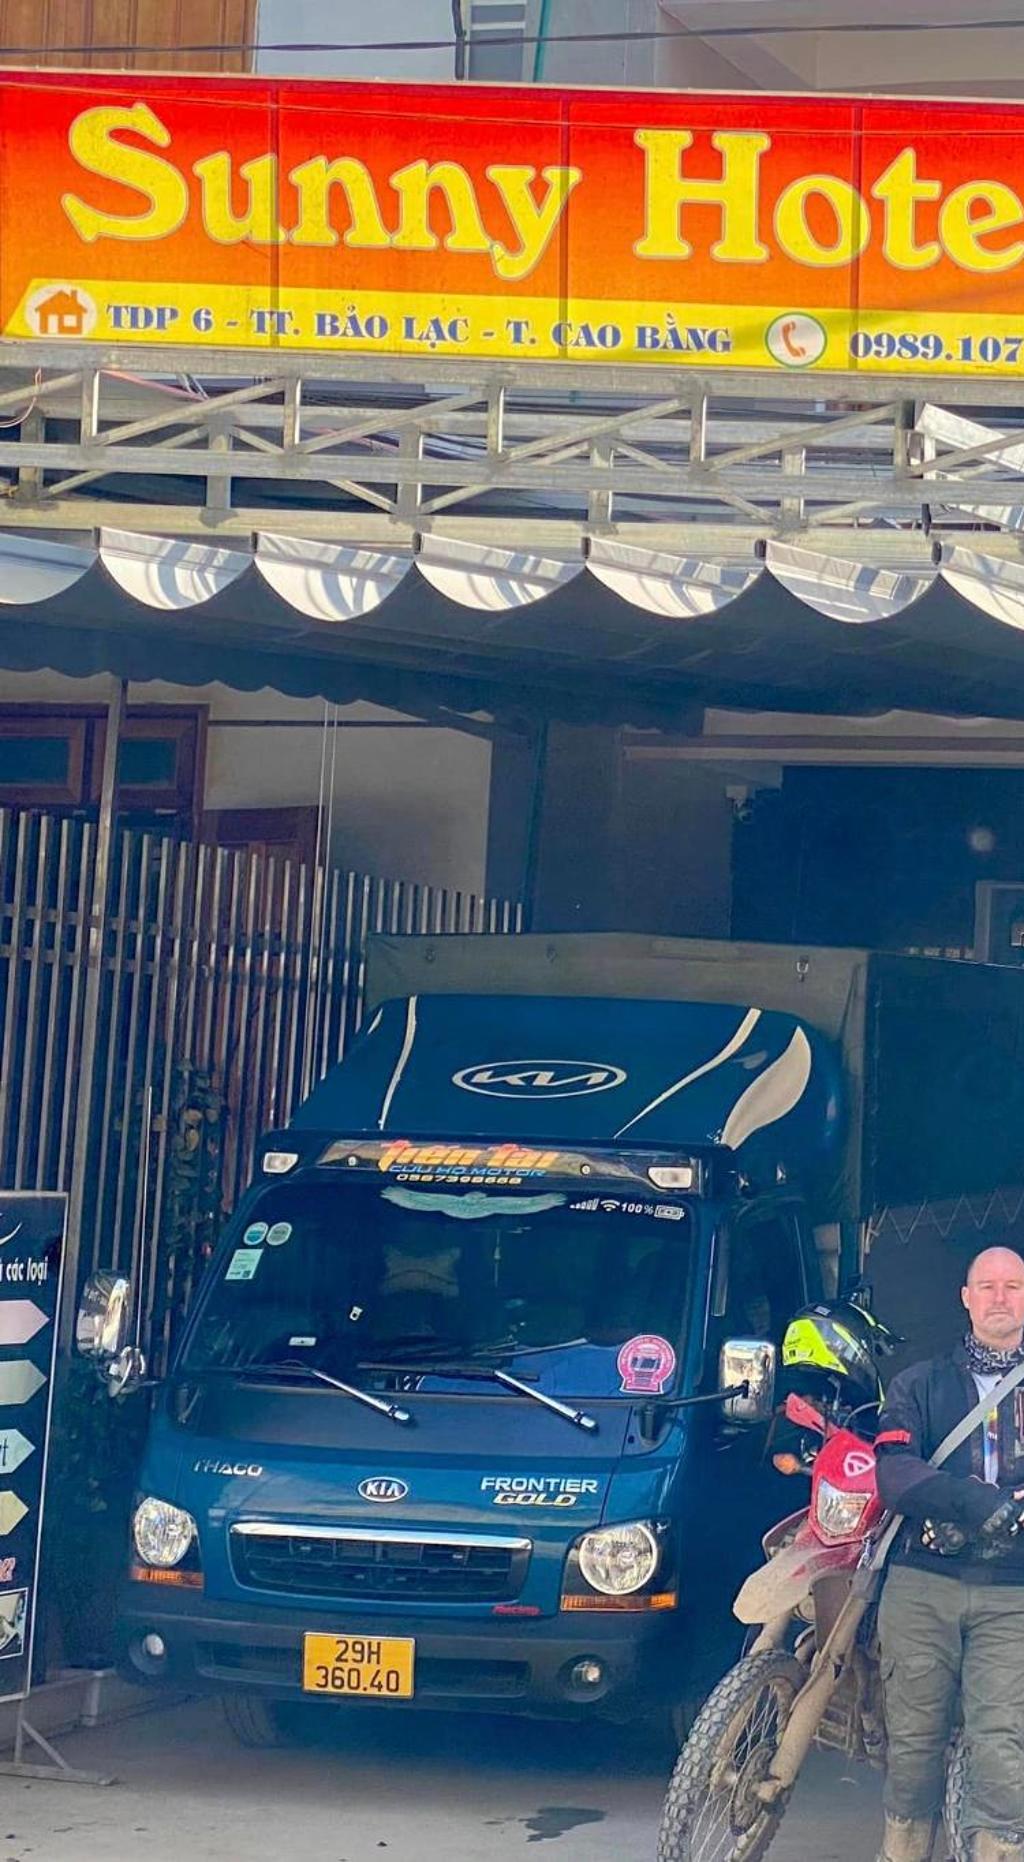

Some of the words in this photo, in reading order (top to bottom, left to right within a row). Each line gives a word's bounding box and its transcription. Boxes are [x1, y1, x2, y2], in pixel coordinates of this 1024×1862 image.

[62, 102, 582, 281] Sunny
[106, 304, 179, 330] TDP
[193, 309, 213, 332] 6
[250, 310, 300, 335] TT.
[315, 305, 388, 339] BẢO
[404, 316, 469, 348] LẠC
[506, 319, 536, 345] T.
[552, 322, 621, 348] CAO
[636, 312, 732, 353] BẰNG
[6, 1257, 24, 1281] các
[26, 1256, 48, 1286] loại
[366, 1481, 400, 1496] KIA
[480, 1477, 598, 1493] FRONTIER
[493, 1493, 577, 1507] GOLD
[335, 1640, 382, 1665] 29H
[315, 1665, 400, 1692] 360.40
